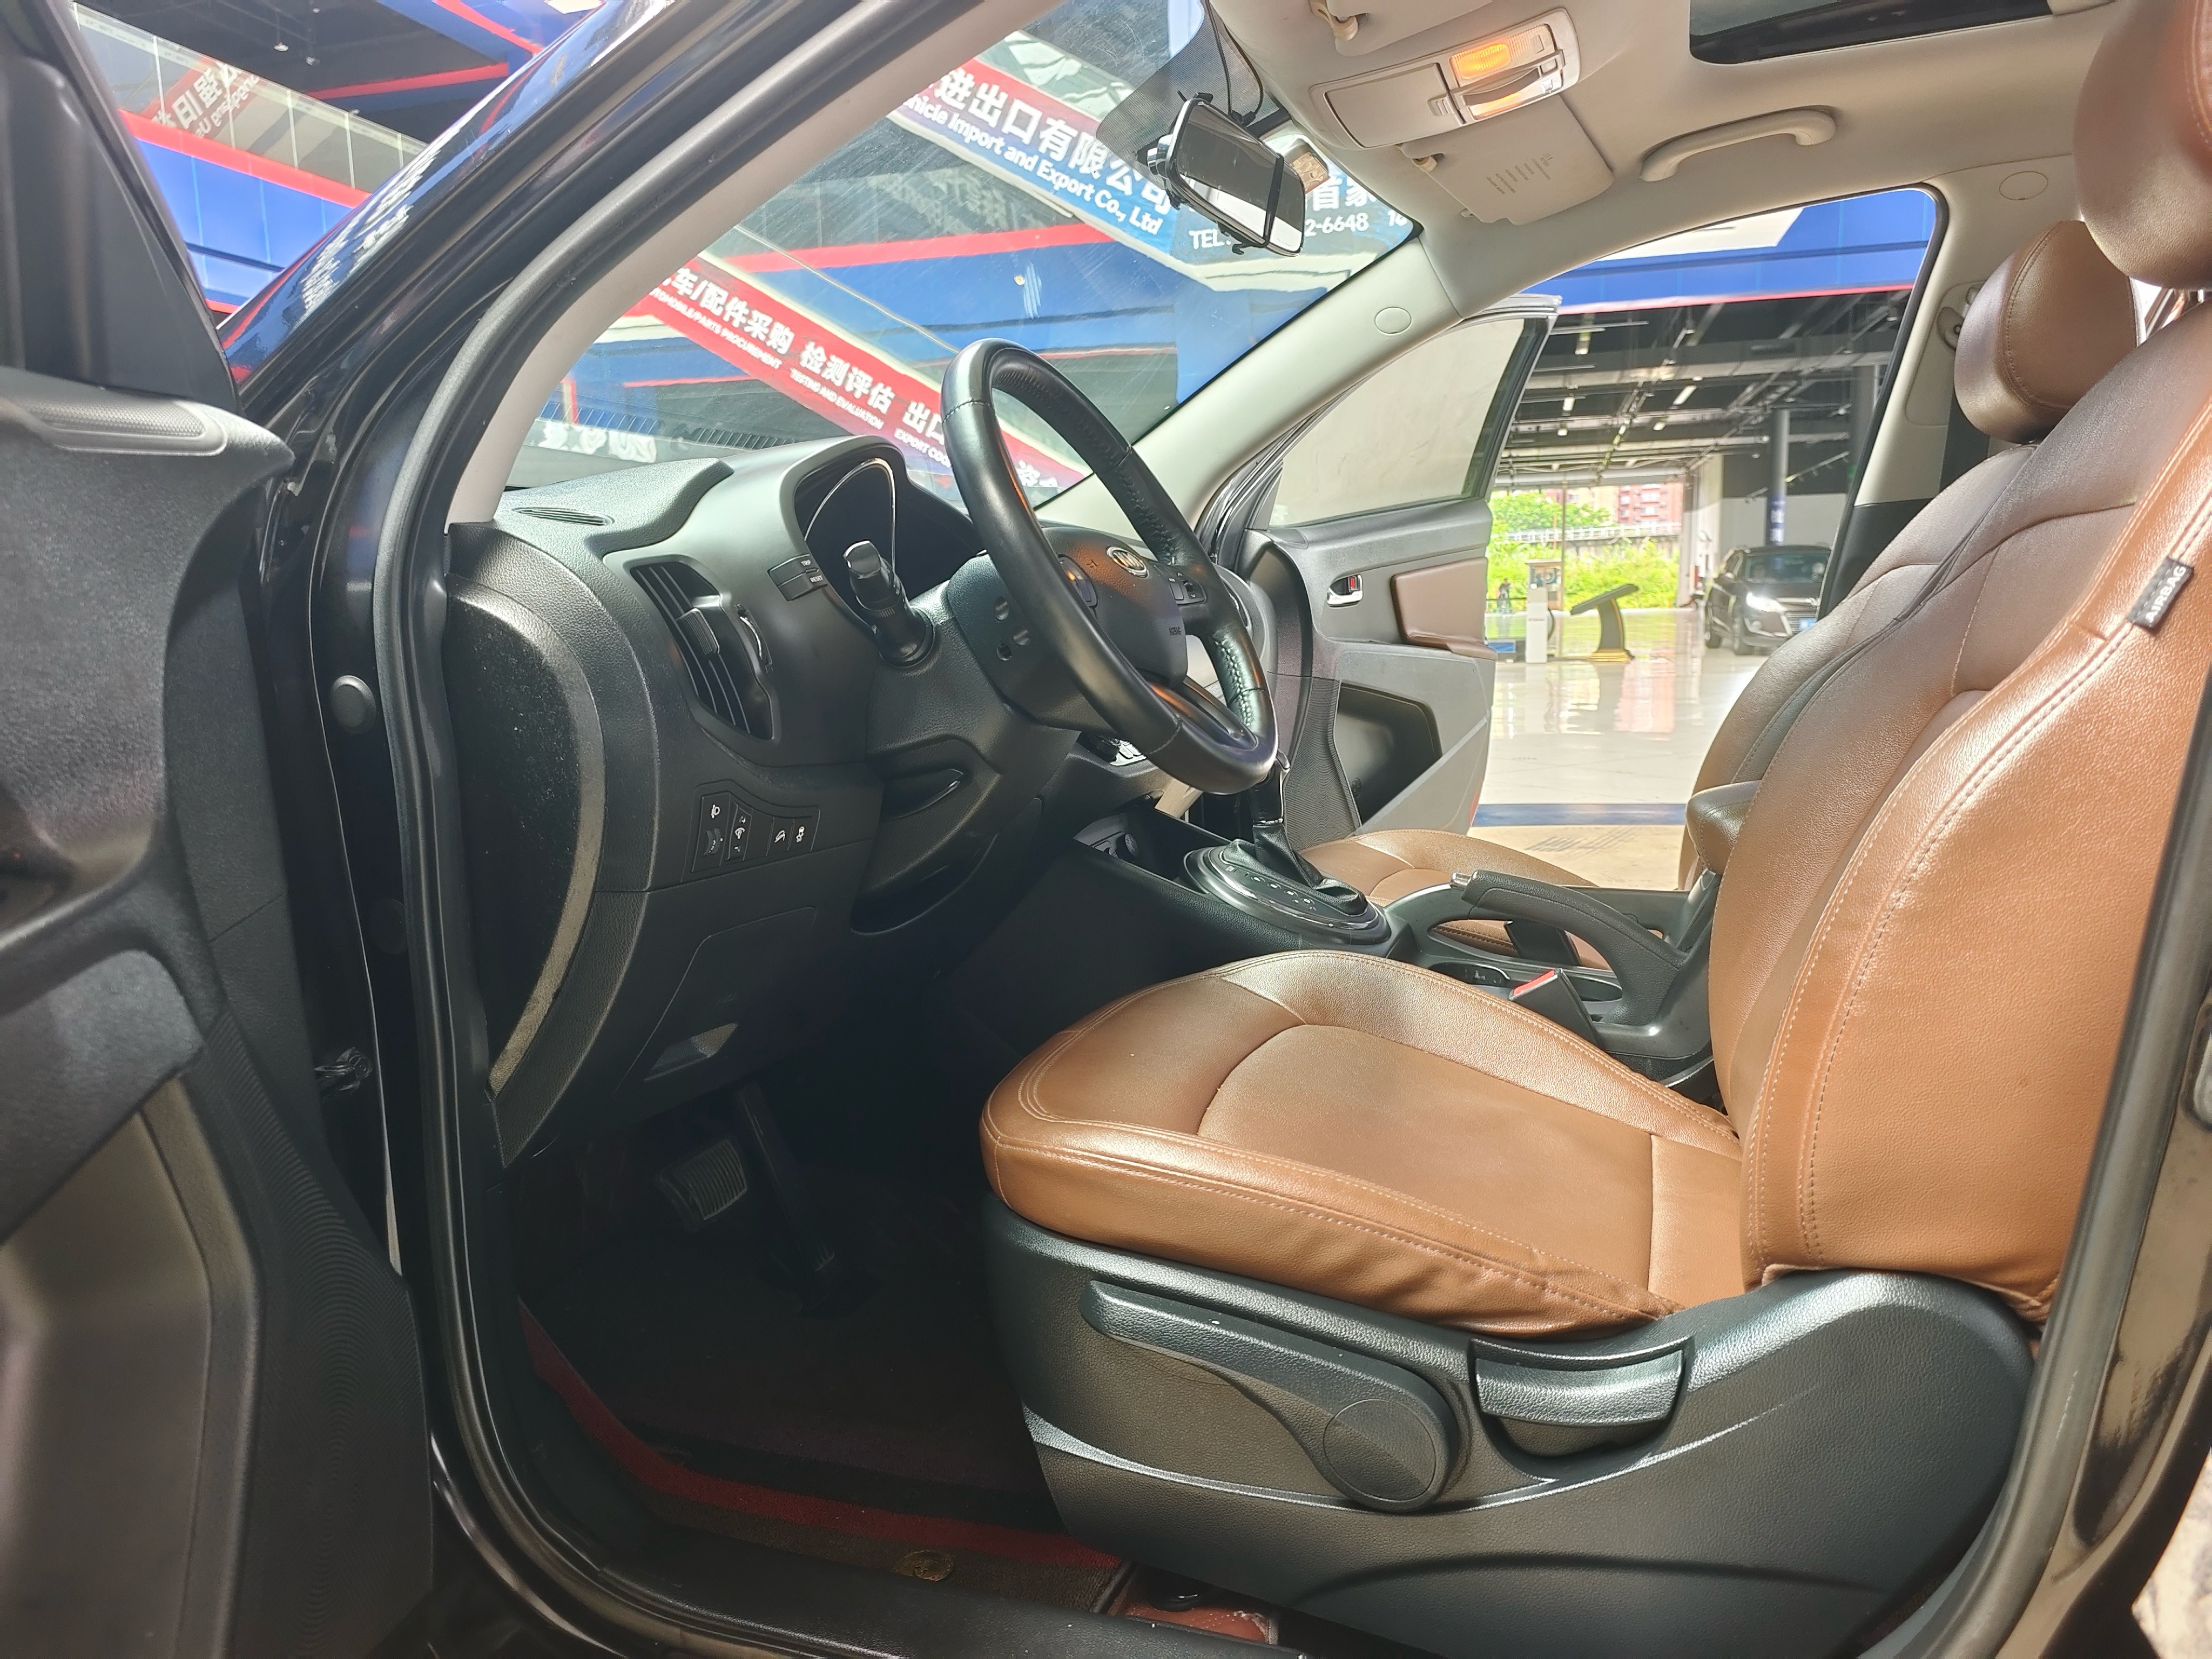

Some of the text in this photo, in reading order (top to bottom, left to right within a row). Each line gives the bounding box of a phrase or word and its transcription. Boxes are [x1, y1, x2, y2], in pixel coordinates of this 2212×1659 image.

[928, 68, 1171, 215] 进出口有限公司
[947, 112, 1006, 155] Import
[1003, 146, 1039, 171] and
[1036, 159, 1095, 201] Export
[1129, 206, 1164, 235] Ltd
[1305, 176, 1377, 211] 首家
[662, 267, 795, 355] 车/配件采购
[799, 341, 895, 415] 检测评估
[720, 327, 783, 369] PROCUREMENT
[819, 385, 838, 403] AND
[894, 428, 931, 454] EXPORT
[810, 575, 824, 583] RESET
[2145, 565, 2187, 623] AIRBAG
